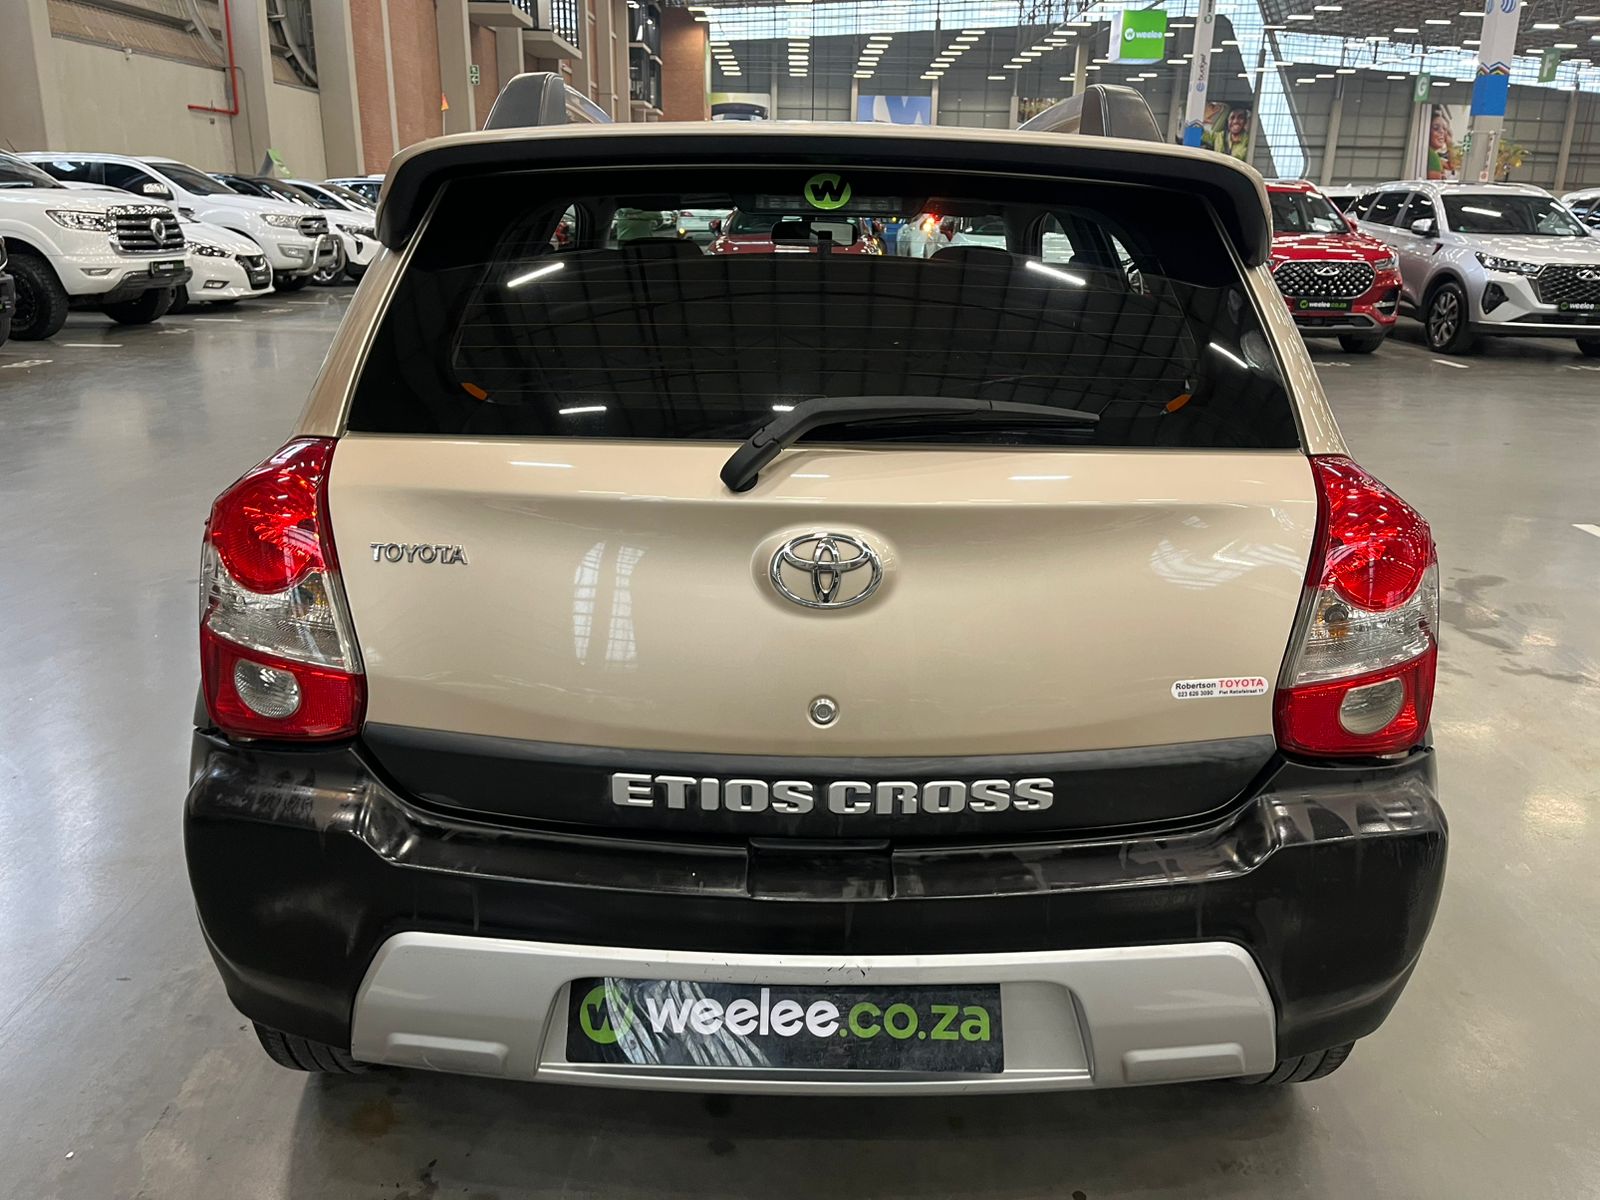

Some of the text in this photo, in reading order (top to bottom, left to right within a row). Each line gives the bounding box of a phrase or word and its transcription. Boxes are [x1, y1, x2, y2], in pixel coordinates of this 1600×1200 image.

[1543, 54, 1555, 77] F
[1418, 77, 1428, 96] G
[369, 542, 468, 565] TOYOTA
[1175, 679, 1264, 690] Robertson TOYOTA
[611, 772, 1055, 815] ETIOS CROSS
[645, 987, 991, 1042] weelee.co.za
